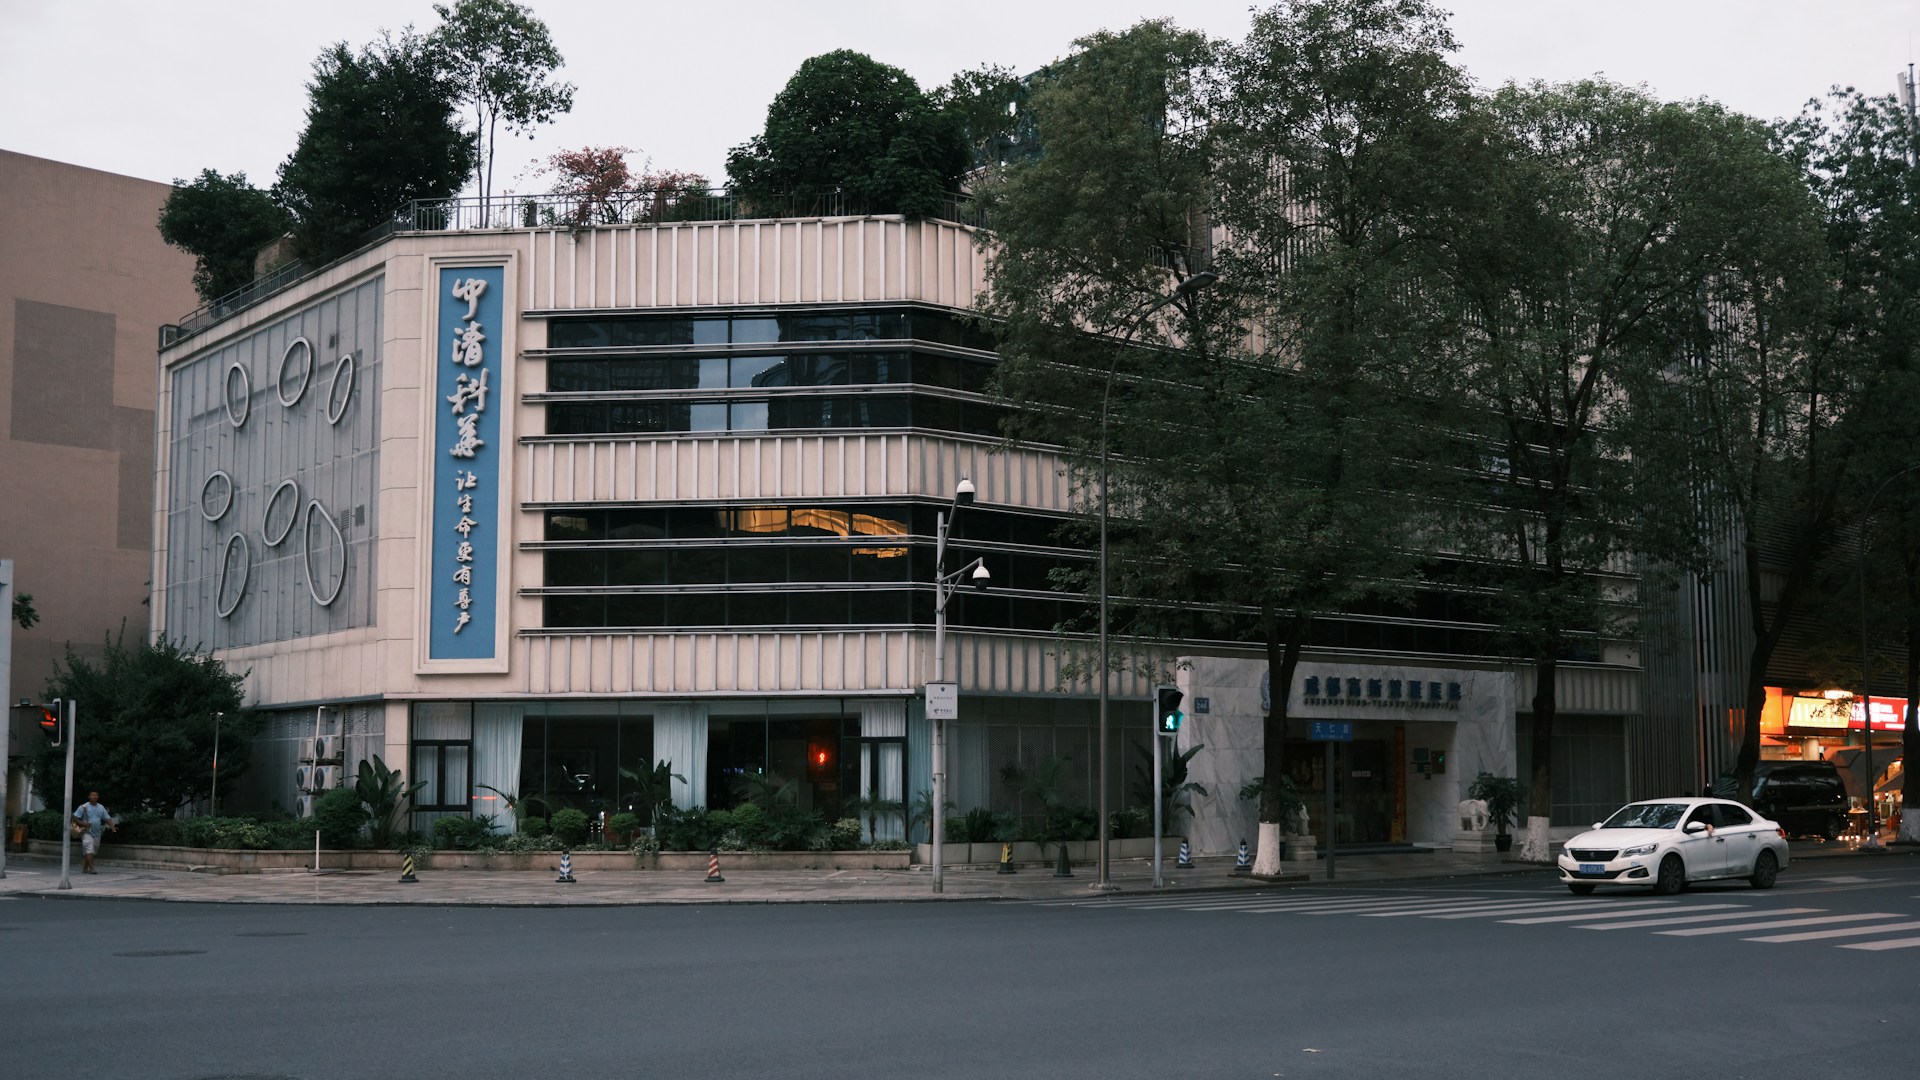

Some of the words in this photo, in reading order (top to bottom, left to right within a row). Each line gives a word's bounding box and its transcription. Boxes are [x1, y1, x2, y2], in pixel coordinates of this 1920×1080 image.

[453, 471, 478, 635] 让生命更有尊严
